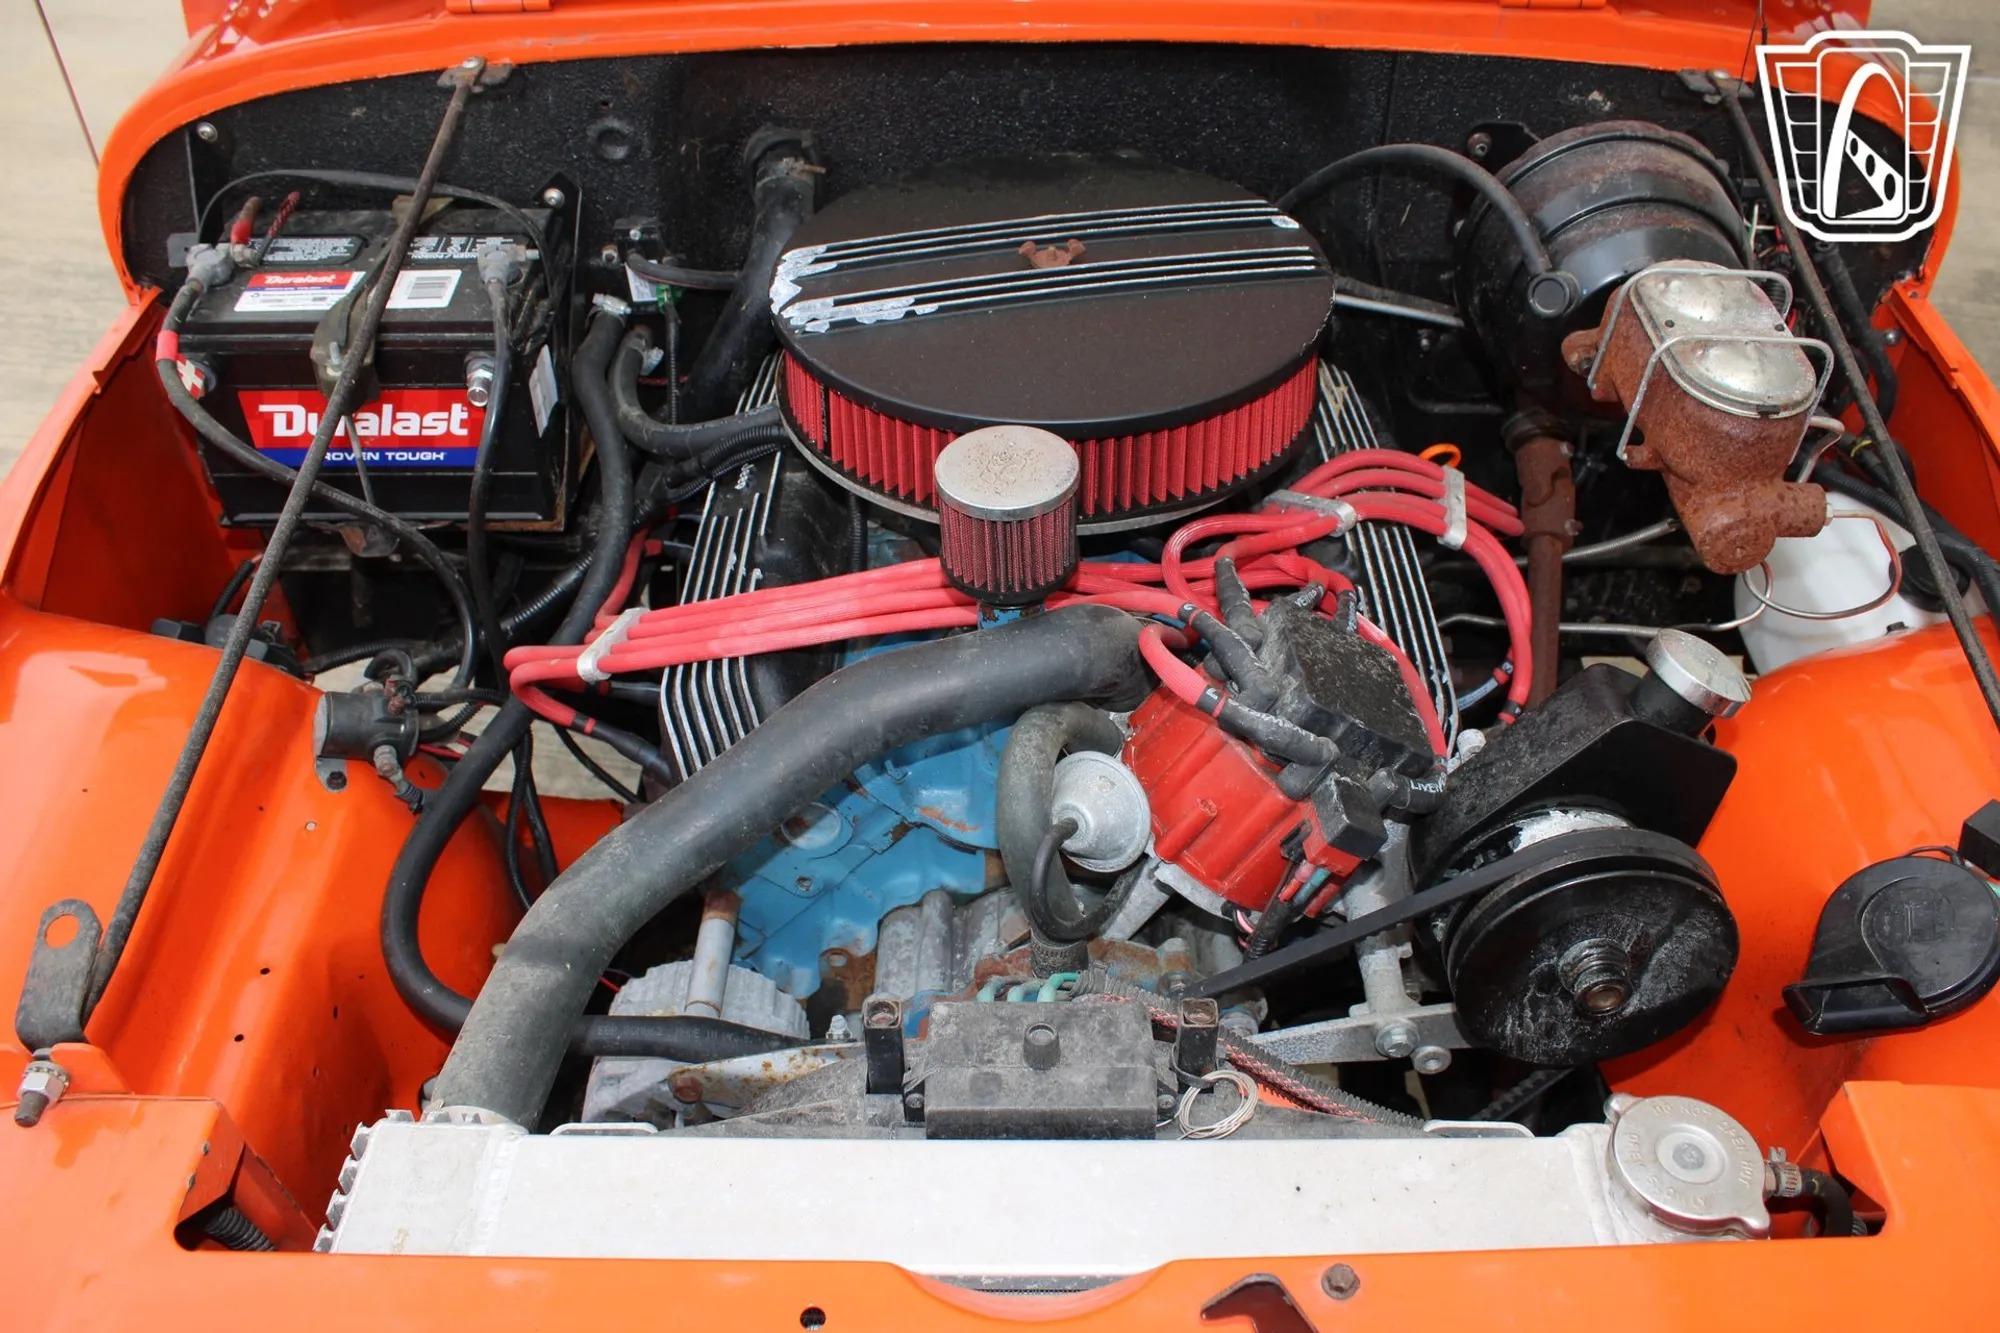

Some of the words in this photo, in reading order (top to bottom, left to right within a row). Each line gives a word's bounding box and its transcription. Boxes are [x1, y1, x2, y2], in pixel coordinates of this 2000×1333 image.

[264, 274, 336, 285] Duralast
[325, 452, 379, 460] ROVN
[385, 452, 444, 460] TOUGH
